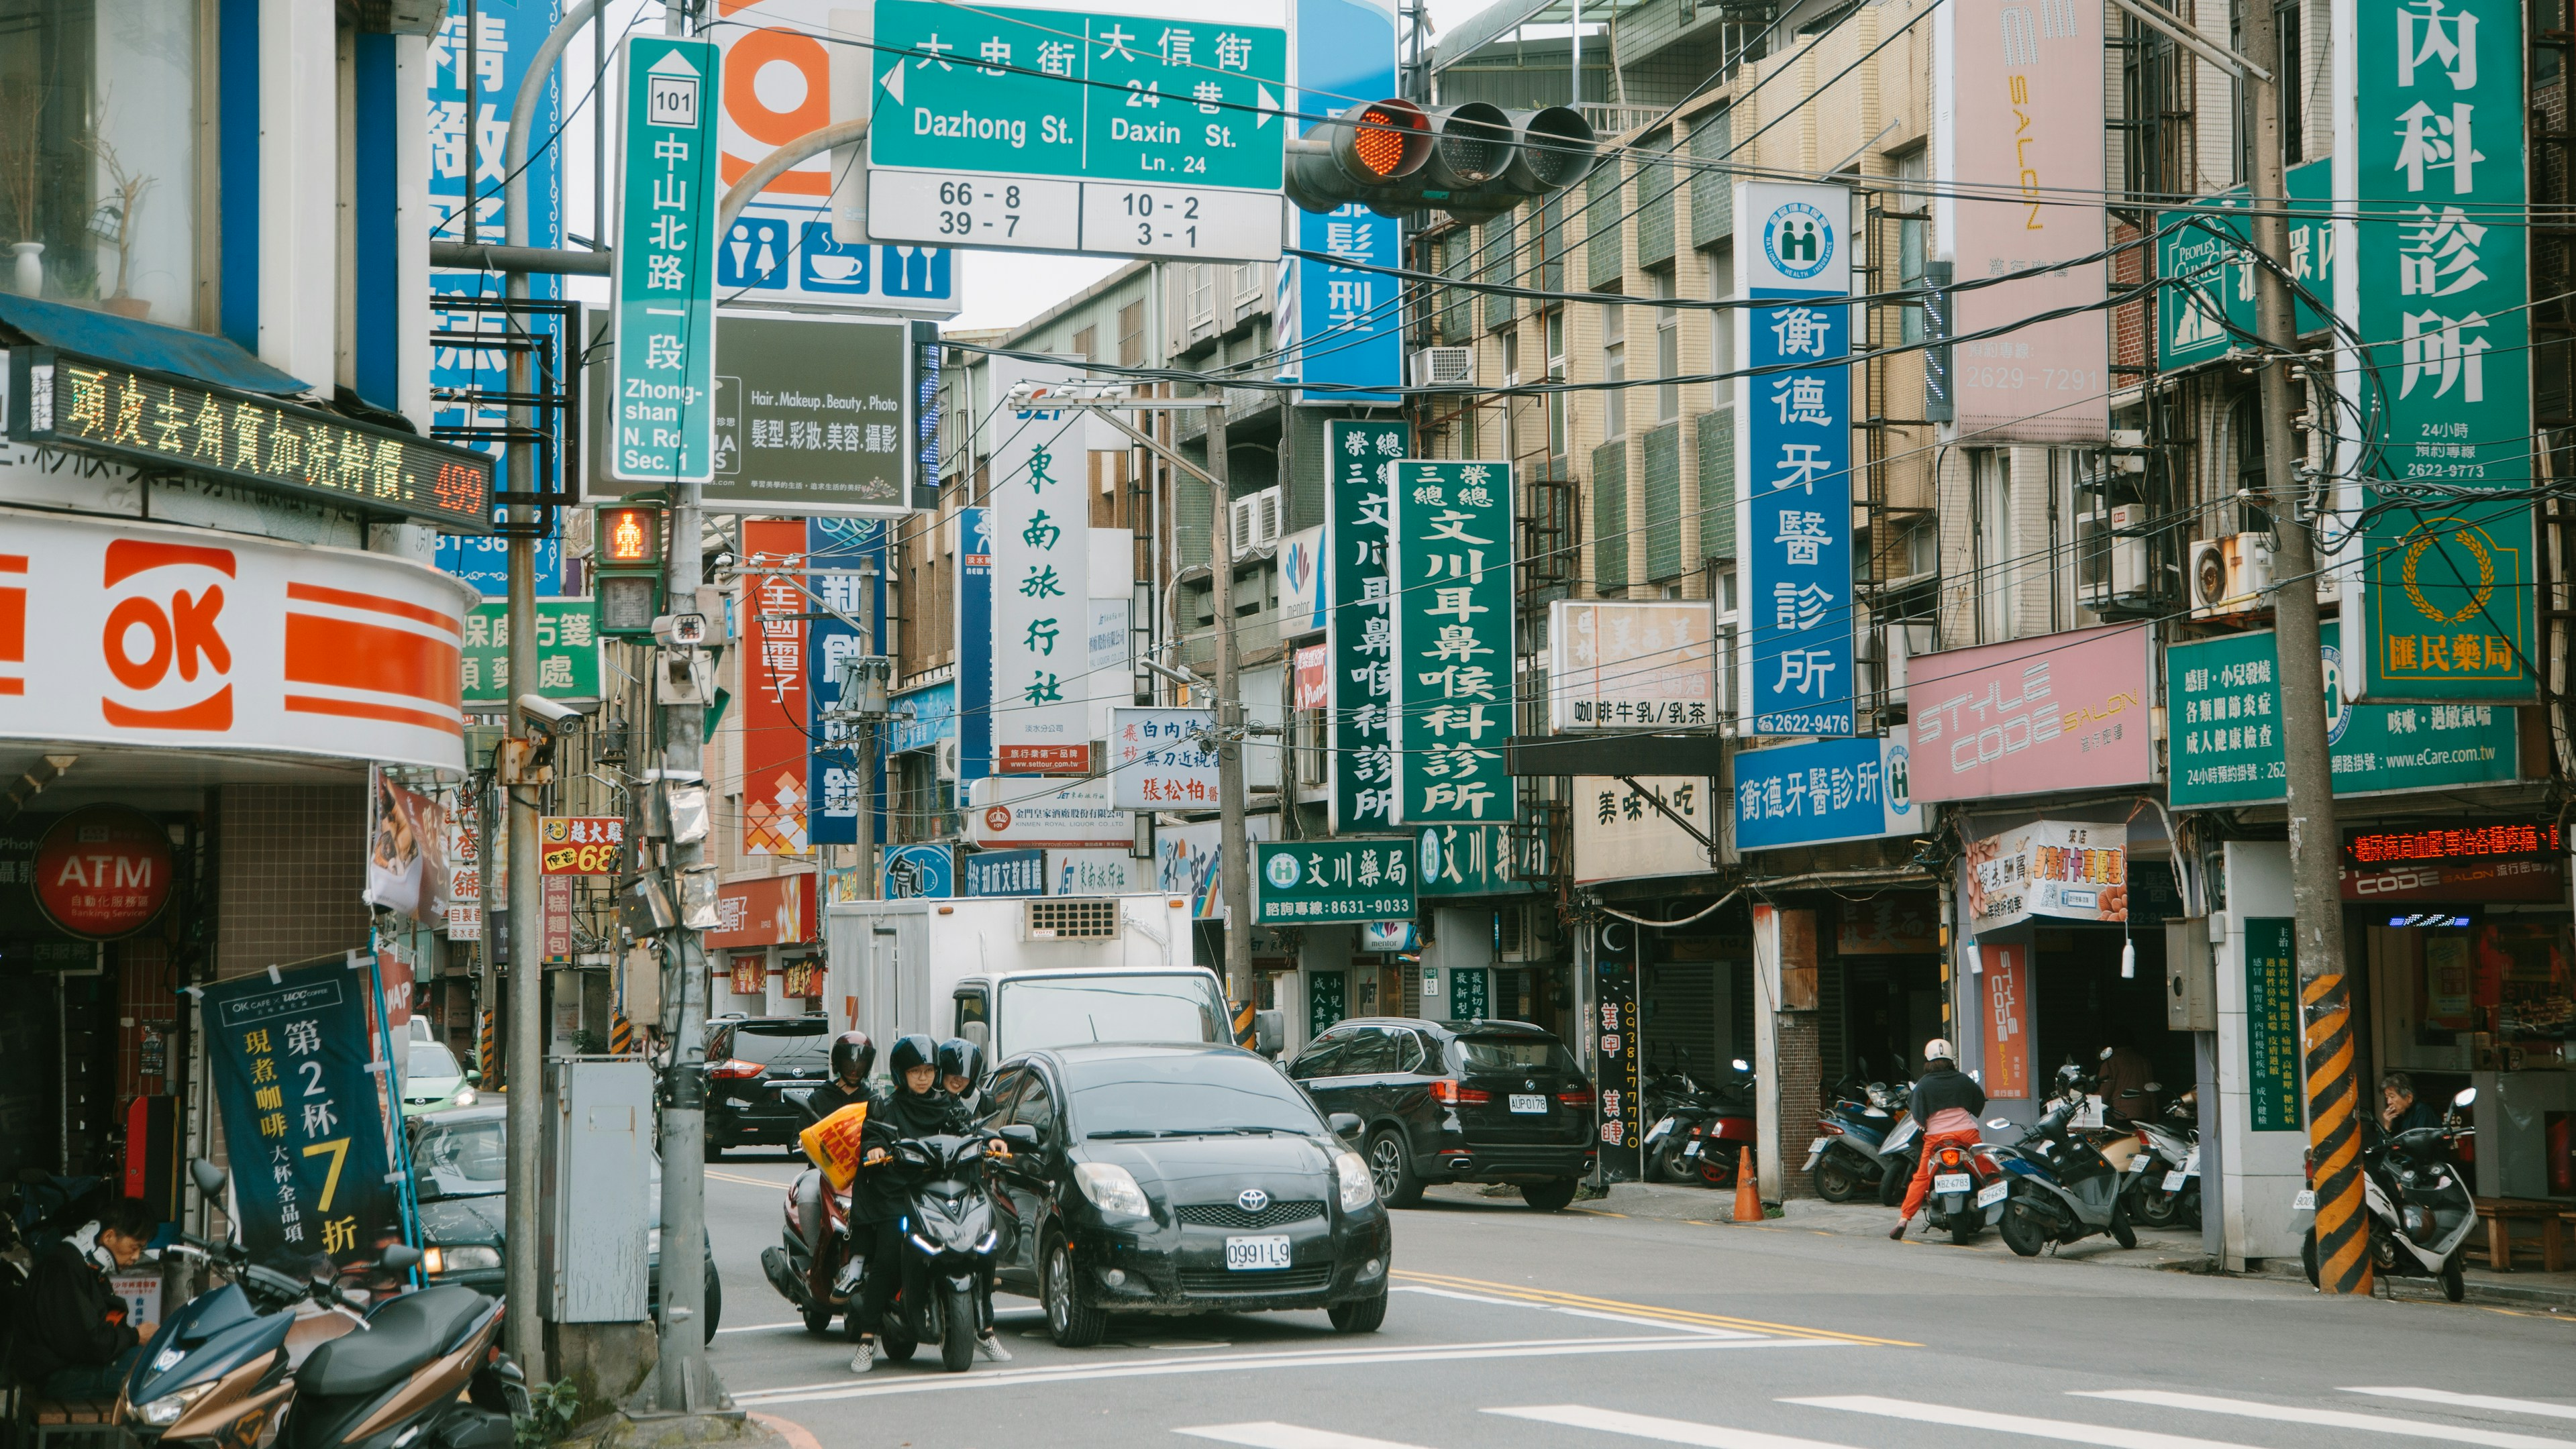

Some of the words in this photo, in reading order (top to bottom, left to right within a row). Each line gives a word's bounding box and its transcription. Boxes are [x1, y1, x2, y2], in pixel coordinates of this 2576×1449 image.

[916, 34, 1076, 77] 大忠街
[1100, 24, 1252, 71] 大信街
[656, 91, 691, 112] 101
[1126, 80, 1160, 109] 24
[1192, 81, 1224, 115] 巷
[915, 107, 1027, 148] Dazhong
[1041, 115, 1074, 145] St.
[1111, 118, 1182, 144] Daxin
[1205, 124, 1237, 148] St.
[1184, 156, 1206, 174] 24
[2009, 75, 2044, 231] SALON
[1769, 203, 1827, 229] 全民健康保險
[2393, 0, 2492, 404] 內科診所
[646, 132, 690, 370] 中山北路一段
[1765, 237, 1782, 268] NATIONAL
[1784, 268, 1810, 278] HEALTH
[1812, 240, 1834, 274] INSURANCE
[2179, 237, 2215, 260] PEOPLE'S
[625, 378, 703, 405] Zhong-
[1966, 366, 2098, 391] 2629-7291
[625, 402, 678, 423] shan
[870, 394, 898, 413] Photo
[623, 427, 651, 447] N.
[653, 429, 688, 449] Rd.
[2421, 422, 2469, 439] 24小時
[623, 450, 670, 470] Sec.
[2416, 441, 2476, 459] 預約專線
[2408, 463, 2485, 479] 2622-9773
[433, 462, 484, 514] 499
[1771, 307, 1837, 700] 衡德牙醫診所
[1019, 443, 1066, 706] 東南旅行社
[1286, 599, 1310, 620] mentor
[103, 583, 232, 691] OK
[760, 572, 800, 704] 全國電子
[1418, 510, 1503, 820] 文川耳鼻喉科診所
[2389, 633, 2515, 672] 匯民藥局
[1574, 700, 1706, 724] 咖啡牛乳/乳茶
[1916, 660, 2052, 745] STYLE
[2063, 688, 2138, 733] SALON
[2186, 692, 2271, 724] 各類關節炎症
[1024, 724, 1064, 733] 淡水分公司
[1775, 714, 1849, 733] 2622-9476
[1950, 701, 2061, 774] CODE
[1010, 749, 1078, 759] 旅行業第一品牌
[1122, 723, 1139, 763] 飛秒
[2186, 724, 2273, 755] 成人健康檢查
[1010, 759, 1079, 768] www.settour.com.tw
[1057, 790, 1070, 800] SET
[1071, 792, 1105, 800] 東南旅行社
[1598, 782, 1696, 826] 美味小吃
[1740, 760, 1879, 822] 衡德牙醫診所
[1015, 808, 1125, 819] 金門皇家酒廠股份有限公司
[2068, 828, 2088, 845] 來店
[56, 855, 152, 888] ATM
[547, 850, 577, 867] 便當
[1306, 849, 1407, 889] 文川藥局
[2356, 871, 2440, 896] CODE
[2442, 870, 2494, 883] SALON
[71, 894, 150, 908] 自動化服務區
[71, 910, 110, 919] Banking
[112, 909, 148, 918] Services
[548, 875, 568, 955] 蛋糕麵包
[1371, 940, 1398, 948] mentor
[2253, 957, 2263, 976] 感冒
[1427, 980, 1435, 994] 93
[1999, 949, 2018, 1035] STYLE
[2266, 957, 2277, 1008] 過敏性鼻炎
[232, 1002, 250, 1013] OK
[306, 988, 329, 998] COFFEE
[1312, 976, 1327, 1035] 成人專用
[1991, 975, 2008, 1042] CODE
[2253, 984, 2264, 1013] 腸胃炎
[1601, 1003, 1621, 1059] 美甲
[2267, 1011, 2278, 1032] 氣喘
[2280, 1002, 2291, 1031] 關節炎
[2255, 1022, 2266, 1079] 內科慢性疾病
[2269, 1036, 2279, 1076] 皮膚過敏
[2281, 1036, 2291, 1055] 痛風
[1625, 1002, 1639, 1148] 0938477770
[1998, 1042, 2010, 1086] SALON
[2283, 1060, 2294, 1089] 高血壓
[1511, 1098, 1546, 1110] AUP-0178
[1601, 1089, 1625, 1146] 美睫
[2256, 1087, 2267, 1126] 成人健檢
[2284, 1094, 2295, 1124] 糖尿病
[243, 1028, 289, 1139] 現煮咖啡
[269, 1144, 305, 1244] 大杯全品項
[818, 1126, 859, 1173] MART
[1936, 1178, 1969, 1189] MBZ-6783
[1979, 1186, 2007, 1203] MCH-6695
[2296, 1196, 2316, 1206] 900-
